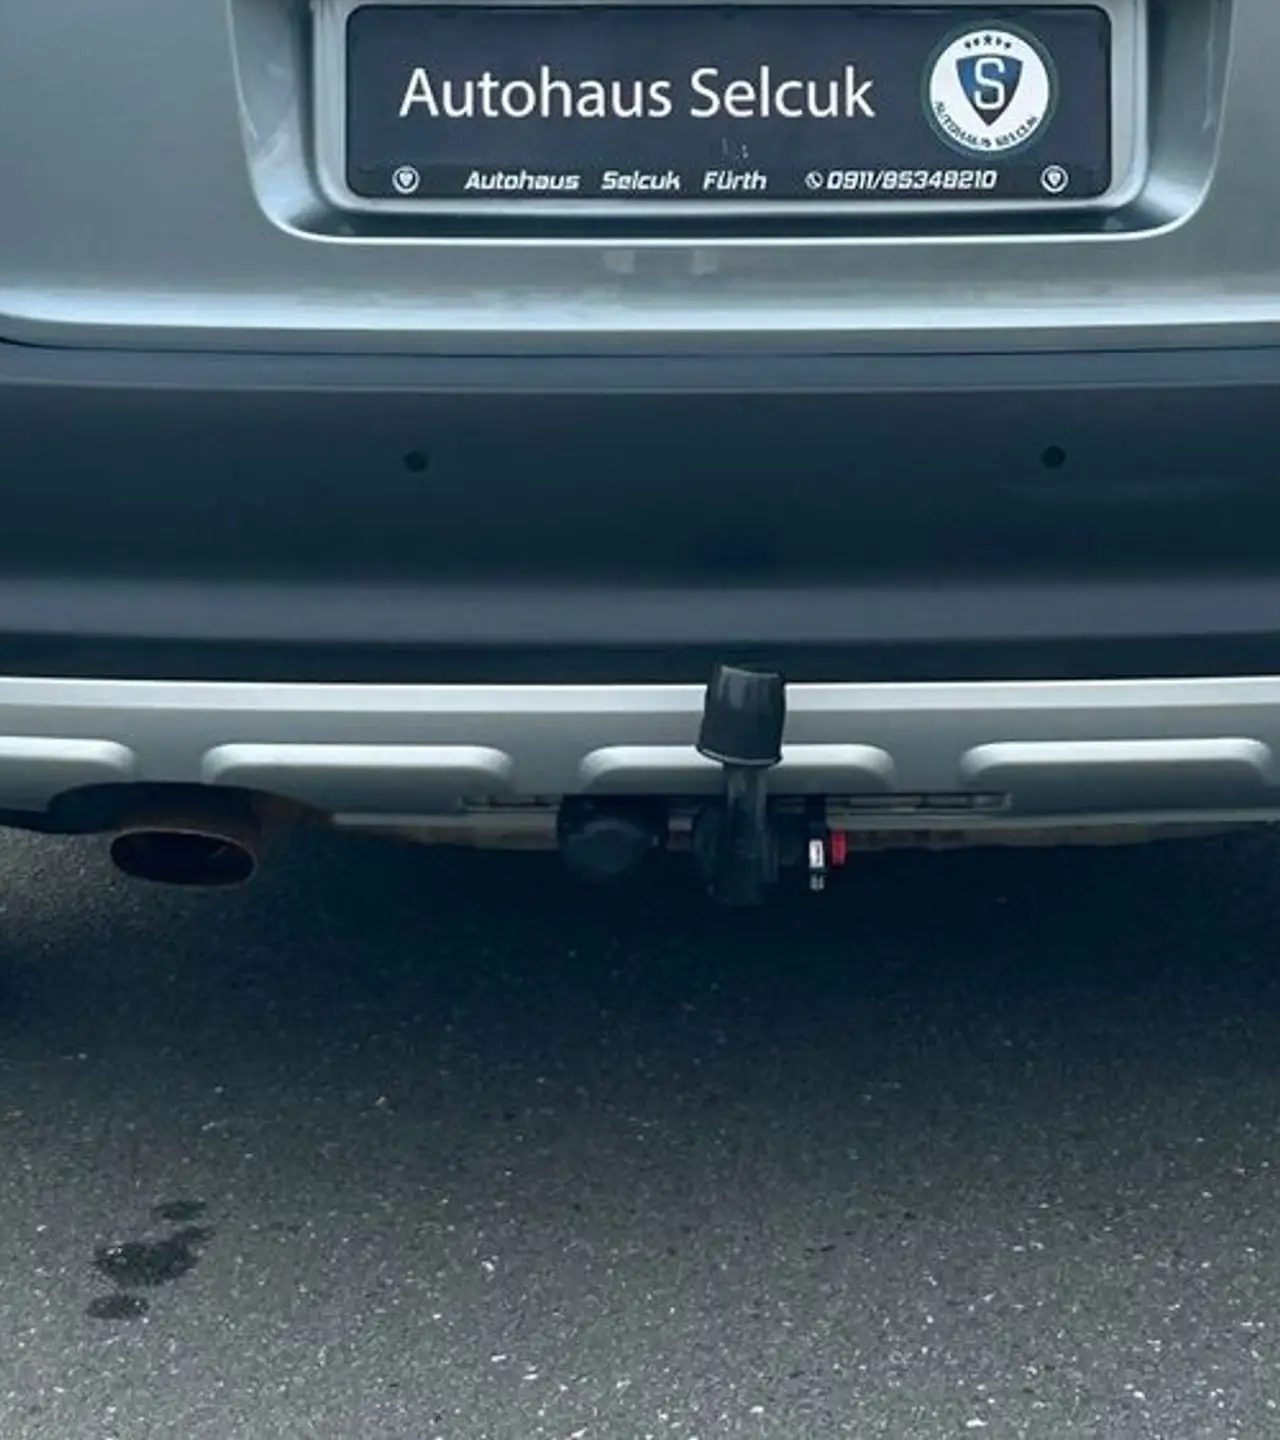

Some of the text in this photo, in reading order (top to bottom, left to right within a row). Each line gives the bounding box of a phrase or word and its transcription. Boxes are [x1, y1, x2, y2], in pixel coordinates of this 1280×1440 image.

[398, 64, 877, 118] Autohaus Selcuk
[974, 57, 1006, 110] S
[464, 169, 581, 191] Autohaus
[600, 169, 682, 191] Selcuk
[702, 169, 768, 191] Fürth
